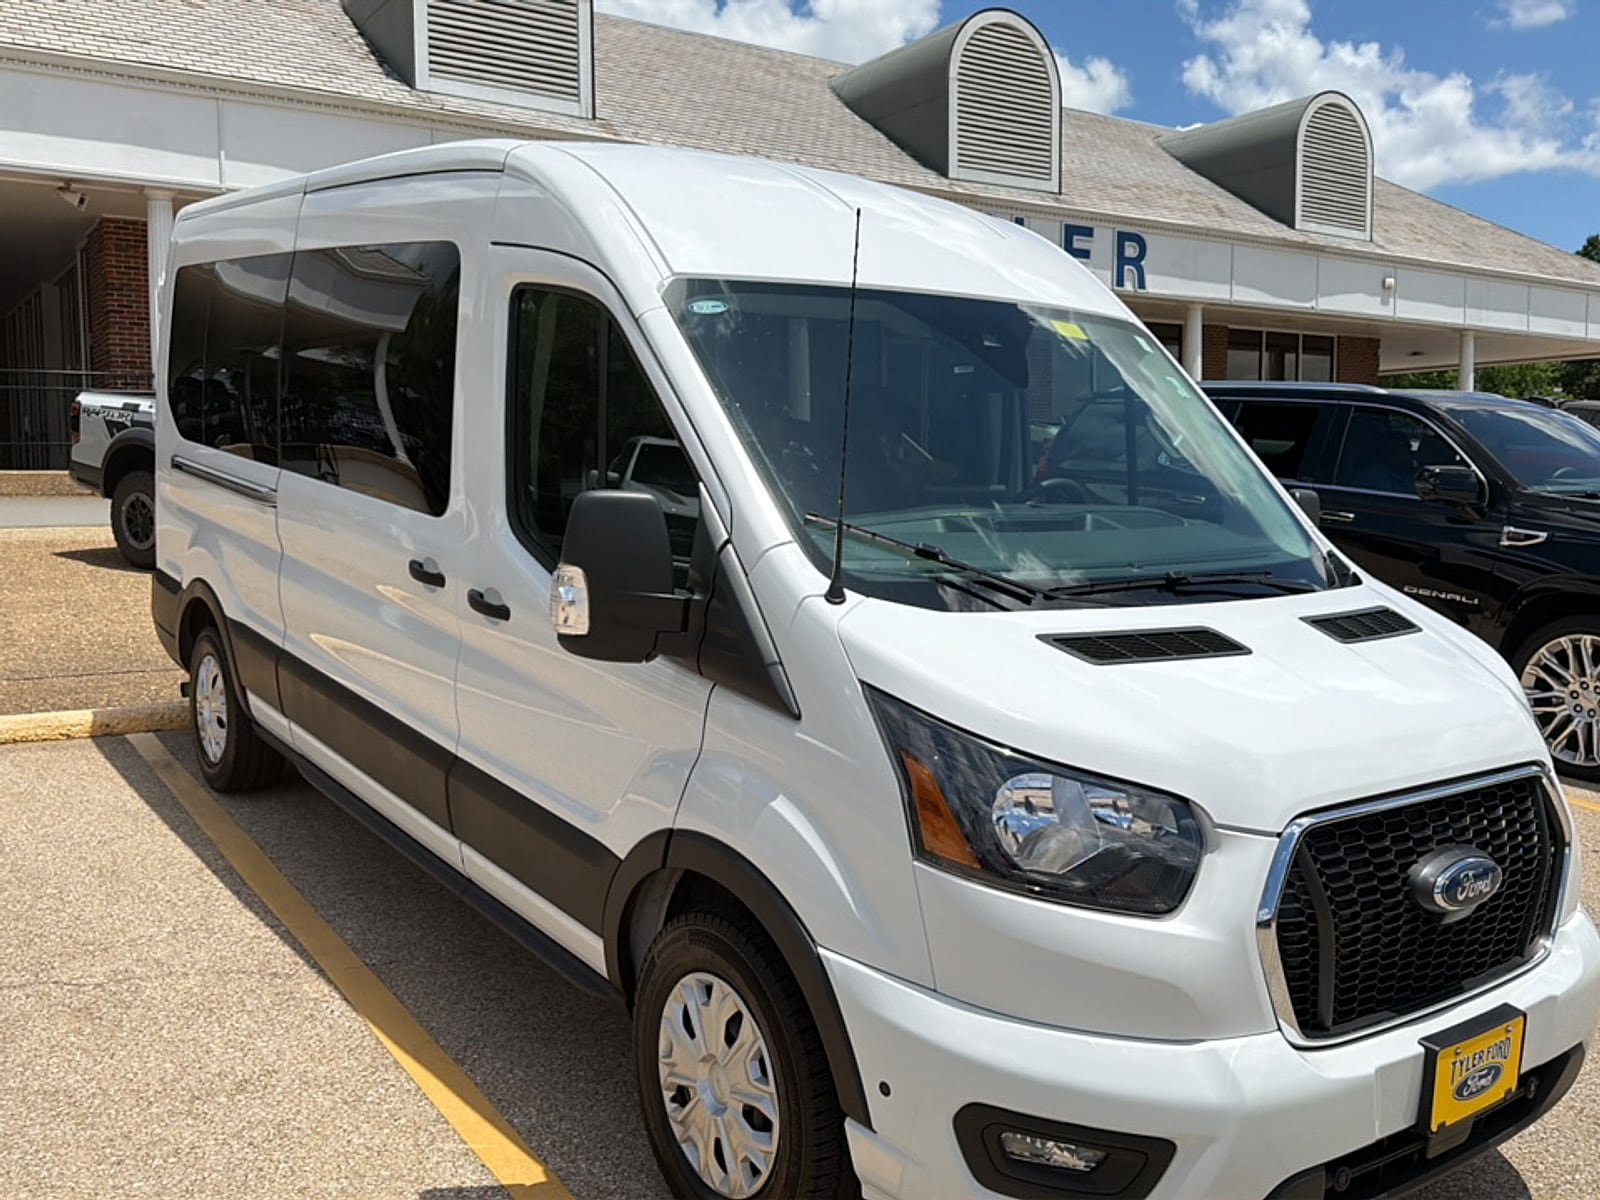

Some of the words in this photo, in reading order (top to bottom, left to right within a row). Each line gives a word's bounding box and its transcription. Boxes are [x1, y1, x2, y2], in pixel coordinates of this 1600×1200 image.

[1403, 585, 1478, 605] DENALI
[1457, 870, 1493, 901] Ford
[1450, 1050, 1485, 1087] TYLER
[1486, 1037, 1511, 1061] FORD
[1463, 1068, 1495, 1096] Ford
